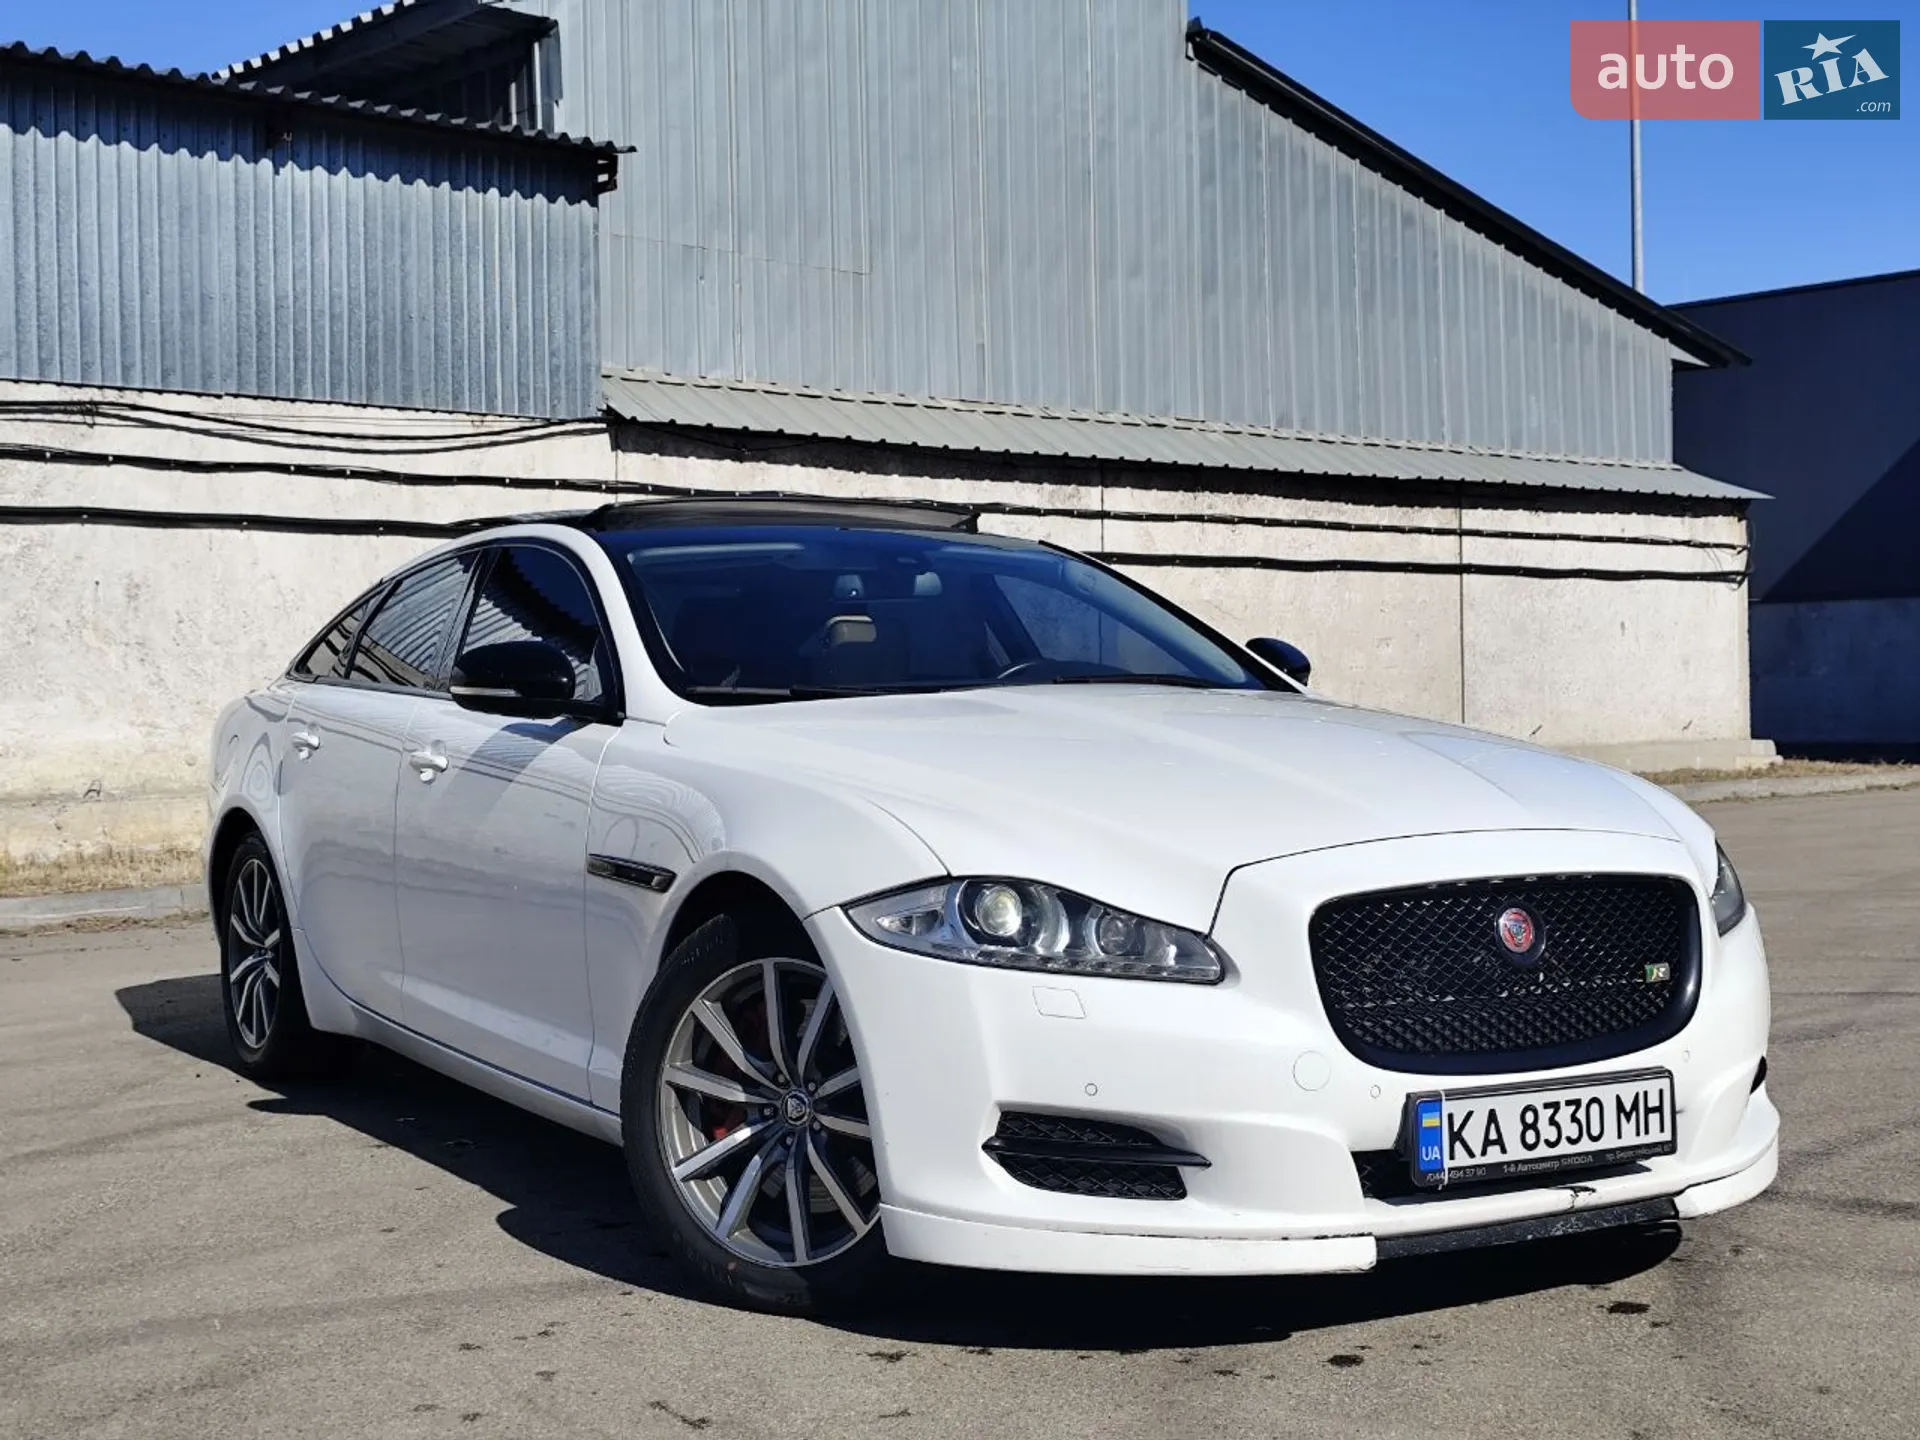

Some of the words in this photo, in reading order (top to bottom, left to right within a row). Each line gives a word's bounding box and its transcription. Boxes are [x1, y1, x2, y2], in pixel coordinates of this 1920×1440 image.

[1447, 1108, 1507, 1161] KA
[1520, 1096, 1604, 1151] 8330
[1615, 1088, 1664, 1138] MH
[1421, 1146, 1441, 1161] UA
